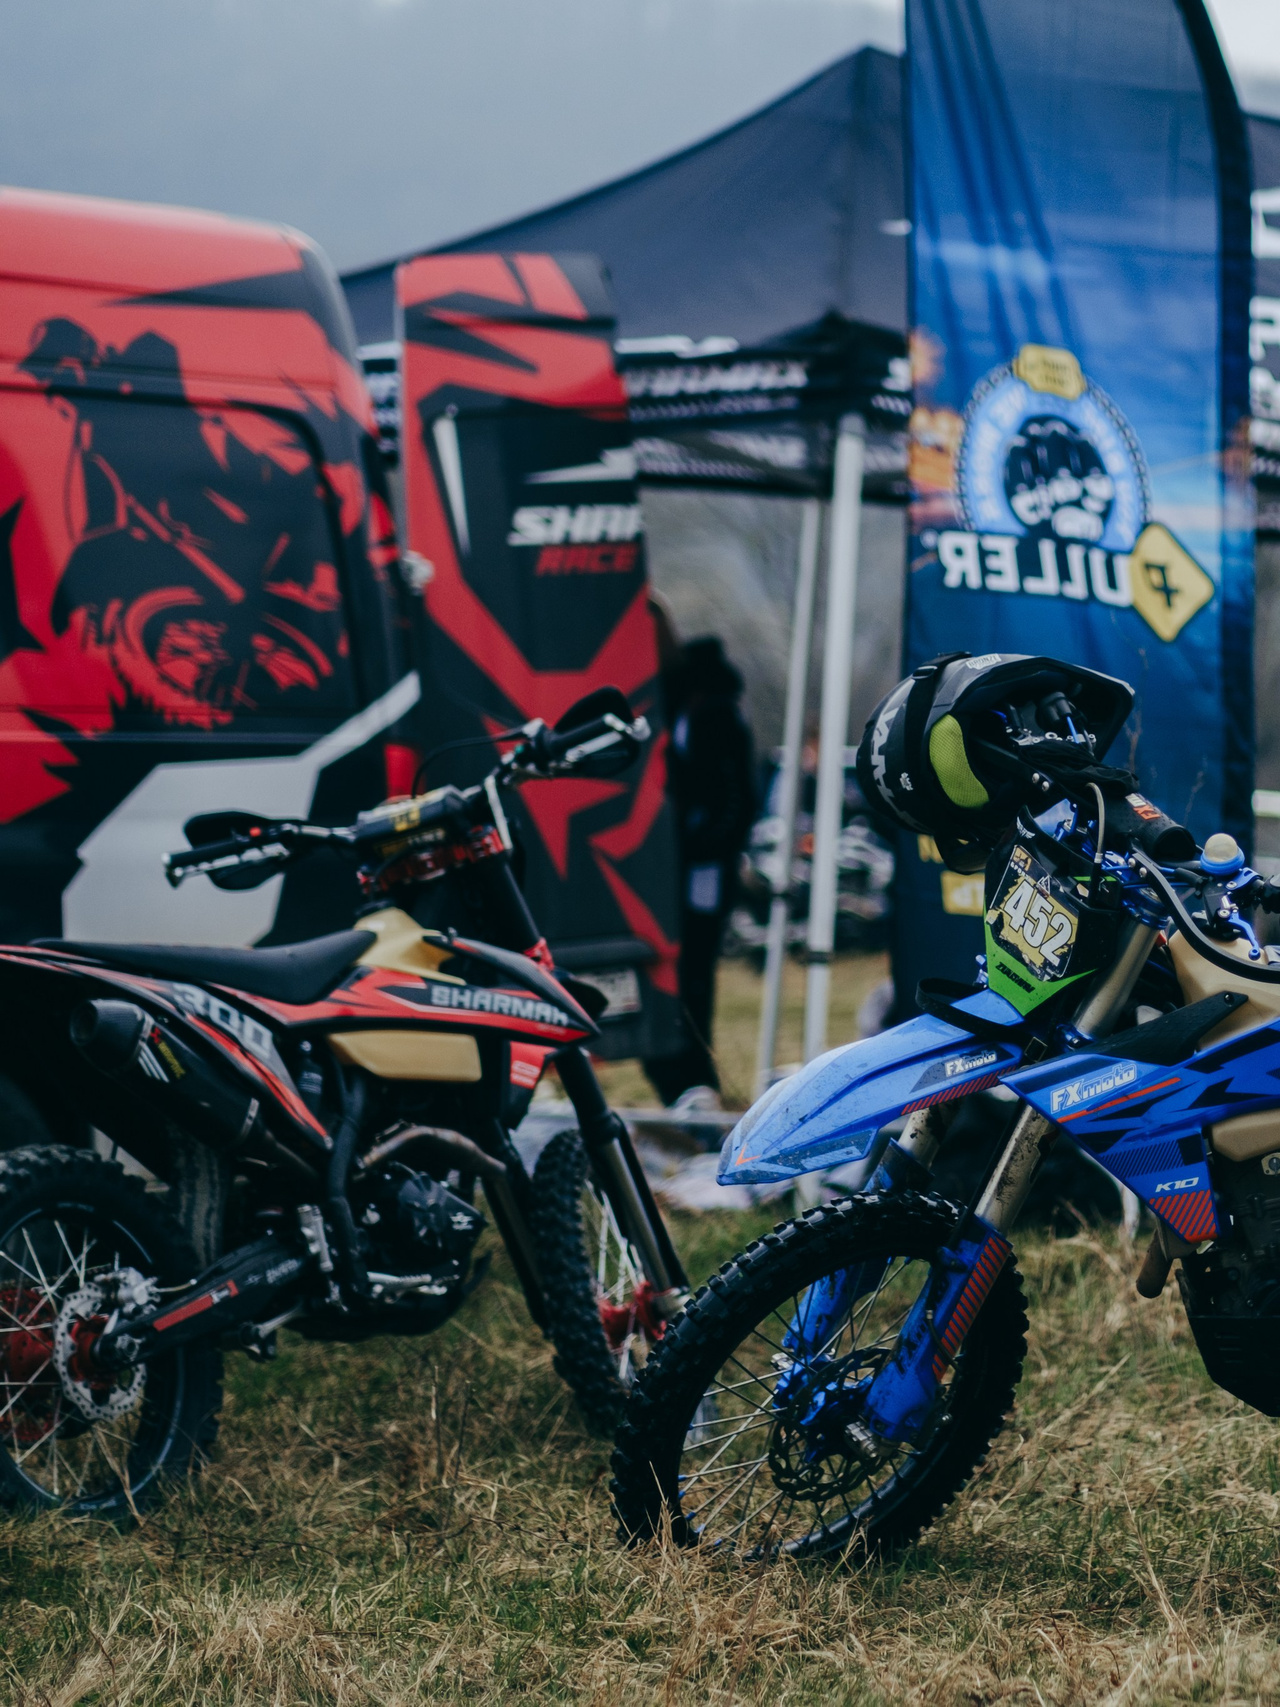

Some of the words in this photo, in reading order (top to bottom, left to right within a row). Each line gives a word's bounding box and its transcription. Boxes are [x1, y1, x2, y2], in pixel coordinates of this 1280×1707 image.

[1003, 878, 1074, 967] 452
[944, 1050, 998, 1078] FXmoto
[1050, 1063, 1138, 1114] FXmoto
[1155, 1176, 1200, 1193] K10
